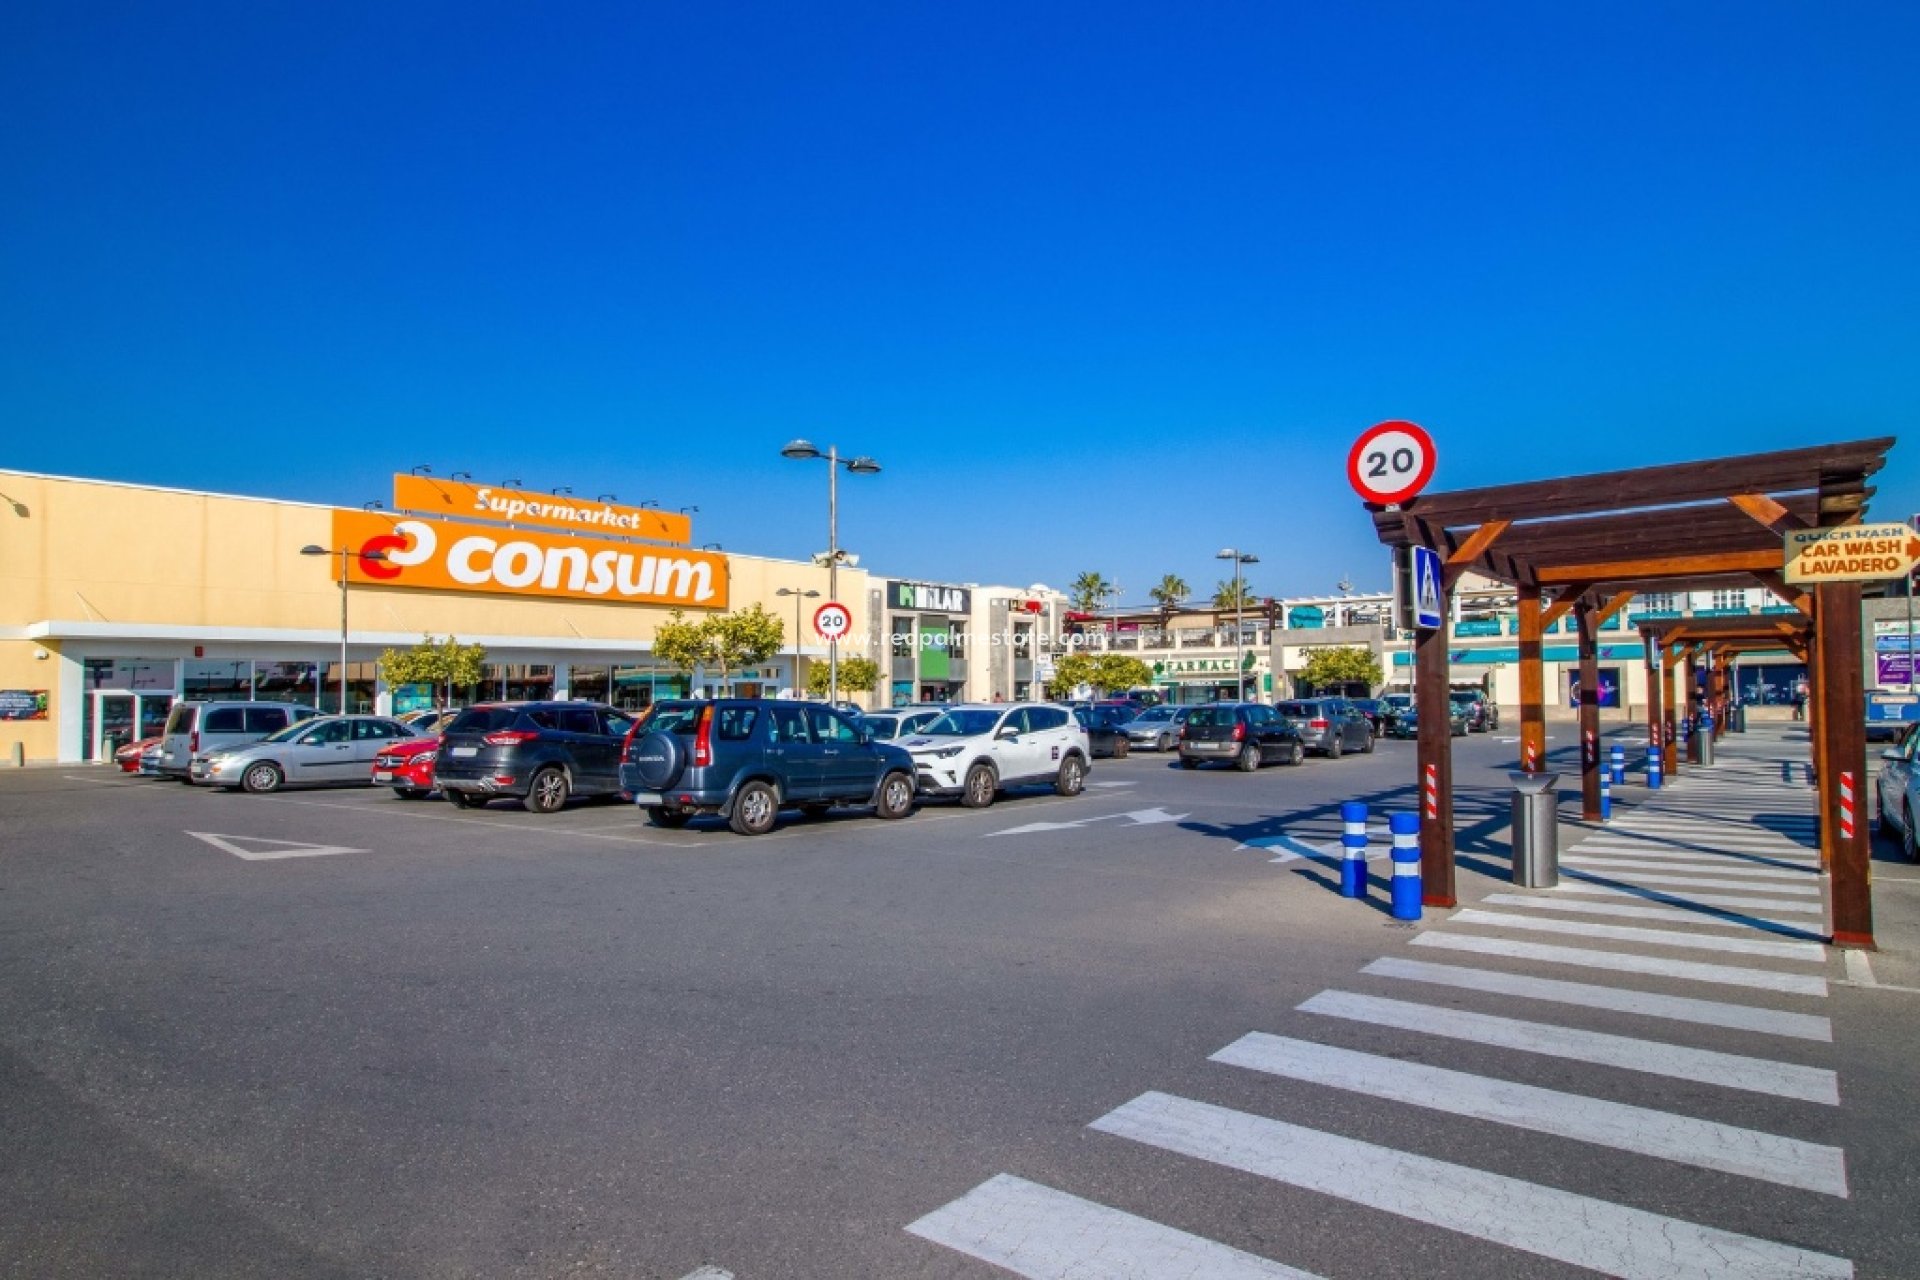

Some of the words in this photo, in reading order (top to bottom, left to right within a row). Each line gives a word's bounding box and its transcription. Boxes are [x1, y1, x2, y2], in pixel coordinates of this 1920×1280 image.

[1366, 448, 1414, 478] 20
[474, 488, 641, 529] Supermarket
[1801, 544, 1840, 557] CAR
[1844, 540, 1901, 555] WASH
[446, 536, 715, 602] consum
[1800, 557, 1900, 576] LAVADERO
[822, 615, 843, 627] 20
